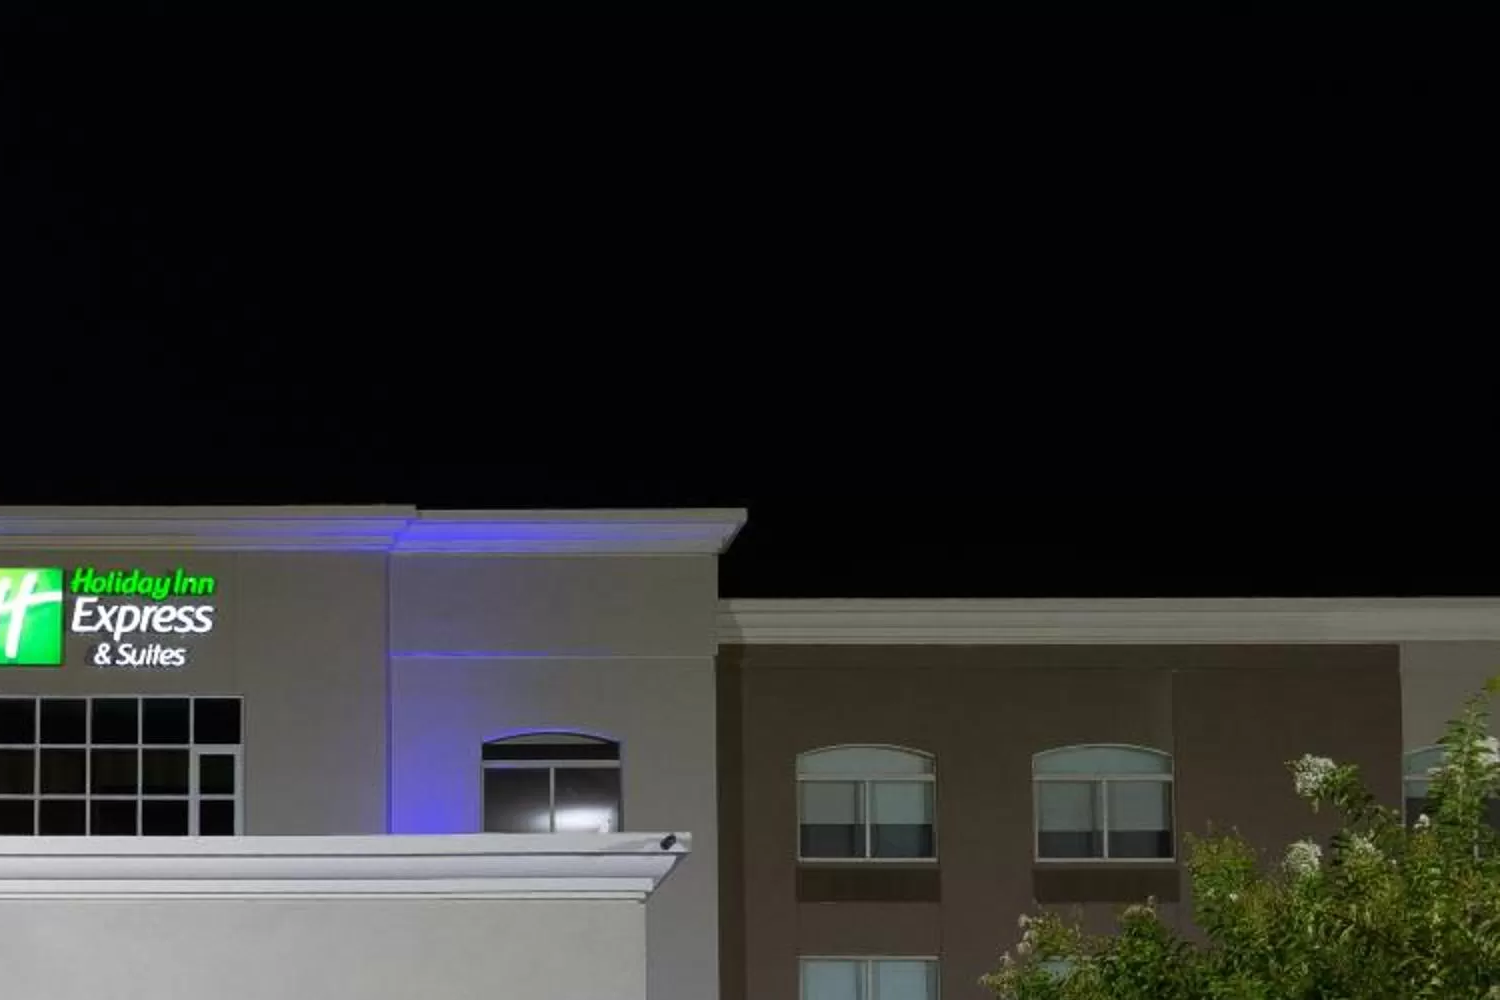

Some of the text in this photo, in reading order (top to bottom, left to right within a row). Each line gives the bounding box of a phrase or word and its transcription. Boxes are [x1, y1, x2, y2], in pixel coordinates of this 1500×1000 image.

[70, 567, 215, 600] Holiday Inn
[71, 596, 214, 641] Express
[94, 643, 187, 665] & Suites
